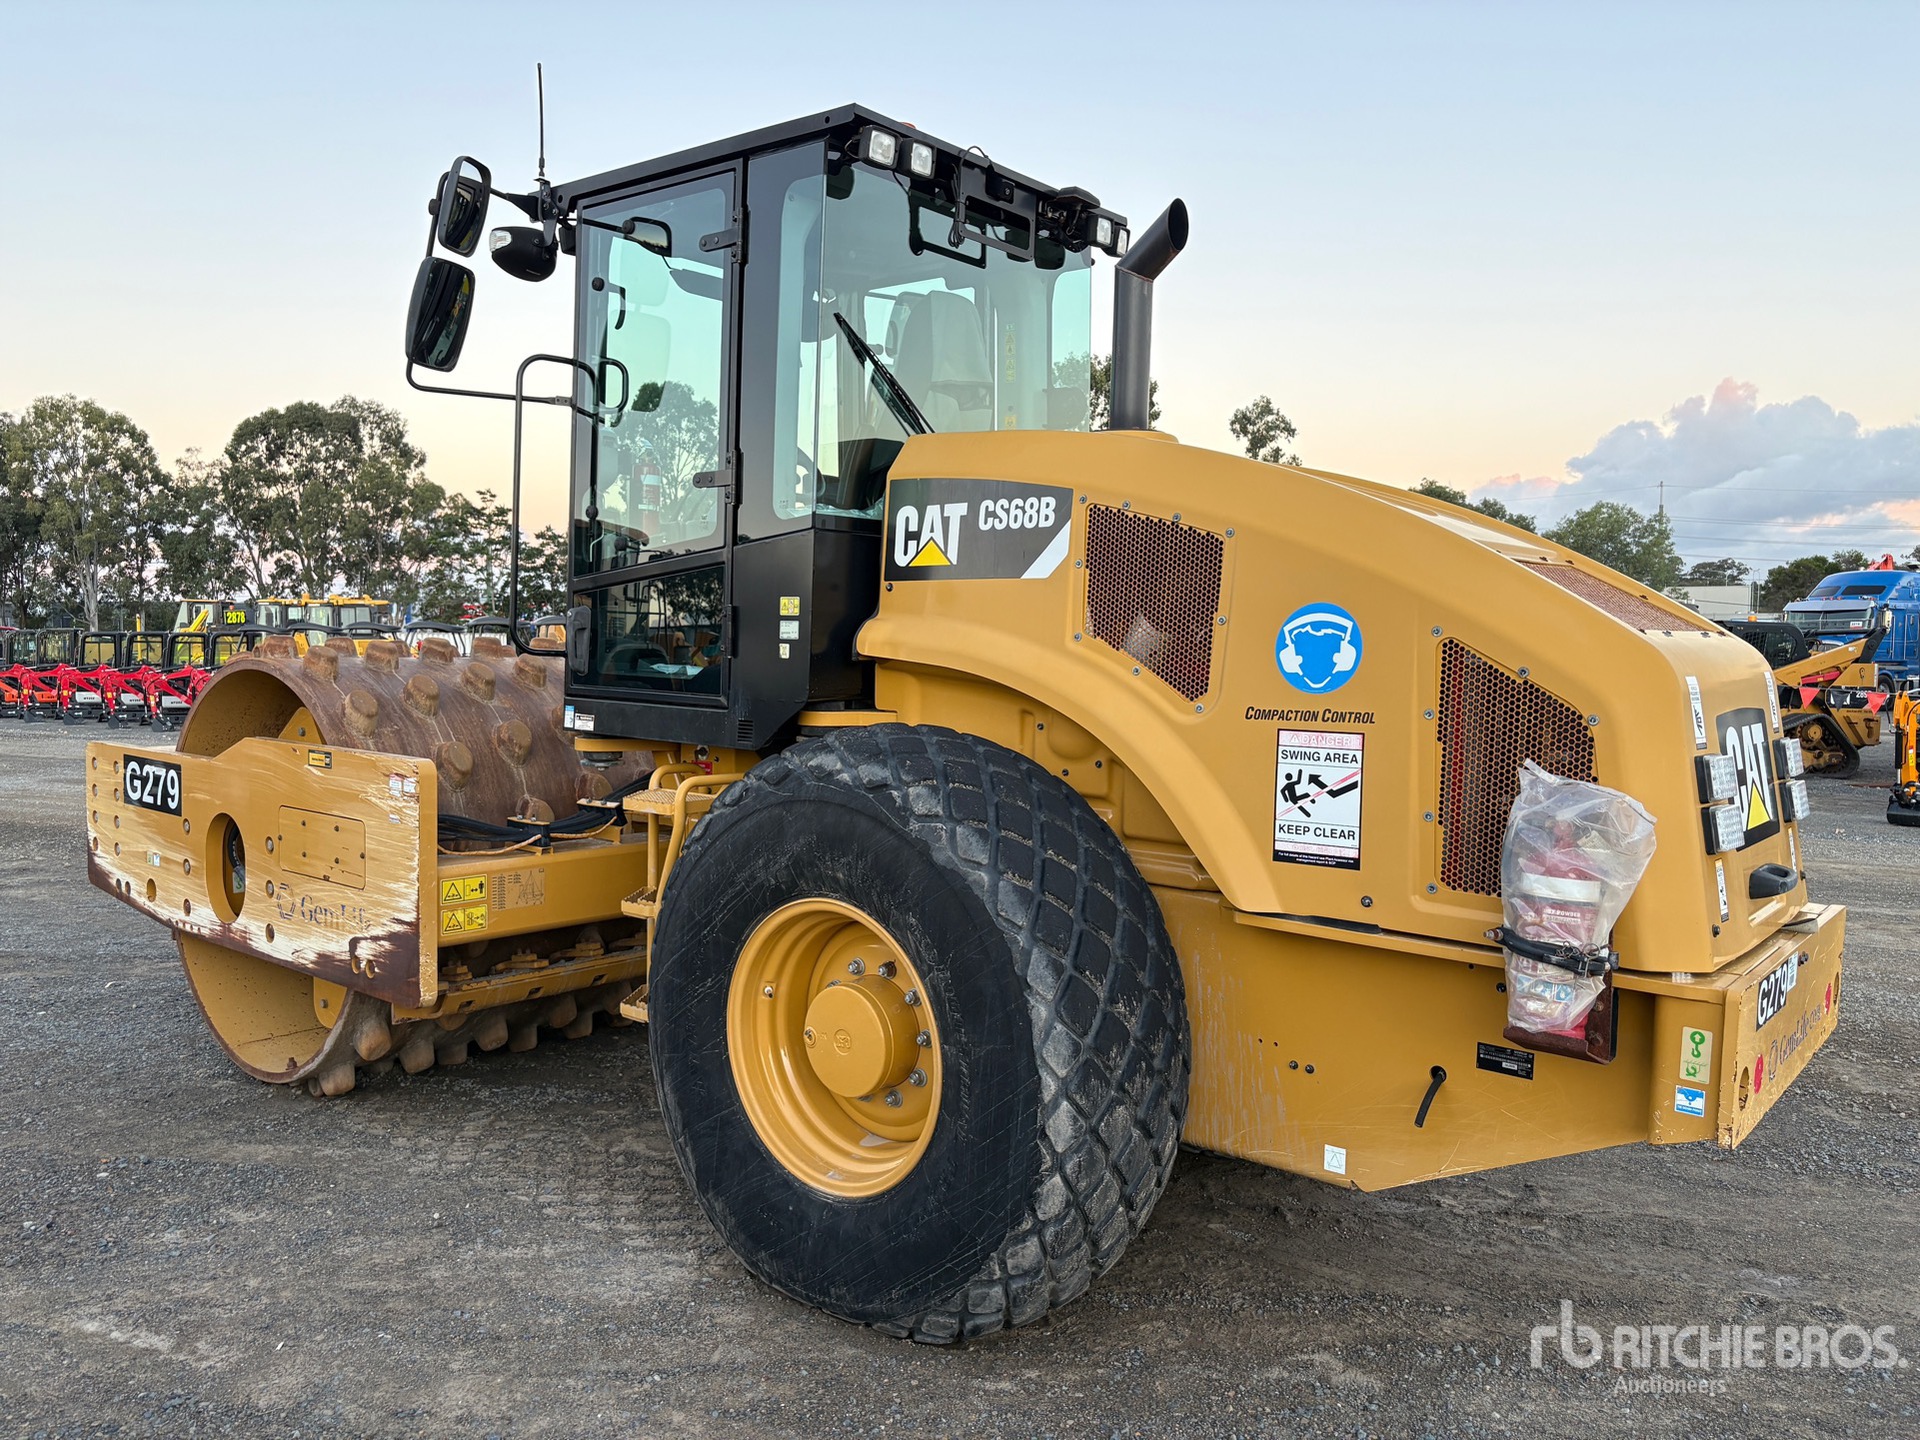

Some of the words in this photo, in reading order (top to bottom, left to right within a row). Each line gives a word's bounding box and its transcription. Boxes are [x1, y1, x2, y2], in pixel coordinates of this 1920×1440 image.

[894, 502, 968, 567] CAT
[978, 496, 1056, 531] CS68B
[226, 611, 246, 624] 2878
[1245, 706, 1319, 722] COMPACTION
[1321, 708, 1376, 724] CONTROL
[1303, 734, 1351, 747] DANGER
[1280, 749, 1321, 762] SWING
[1323, 752, 1358, 764] AREA
[126, 761, 180, 810] G279
[1726, 723, 1772, 832] CAT
[1278, 823, 1311, 836] KEEP
[1313, 827, 1356, 841] CLEAR
[1758, 962, 1789, 1025] G279
